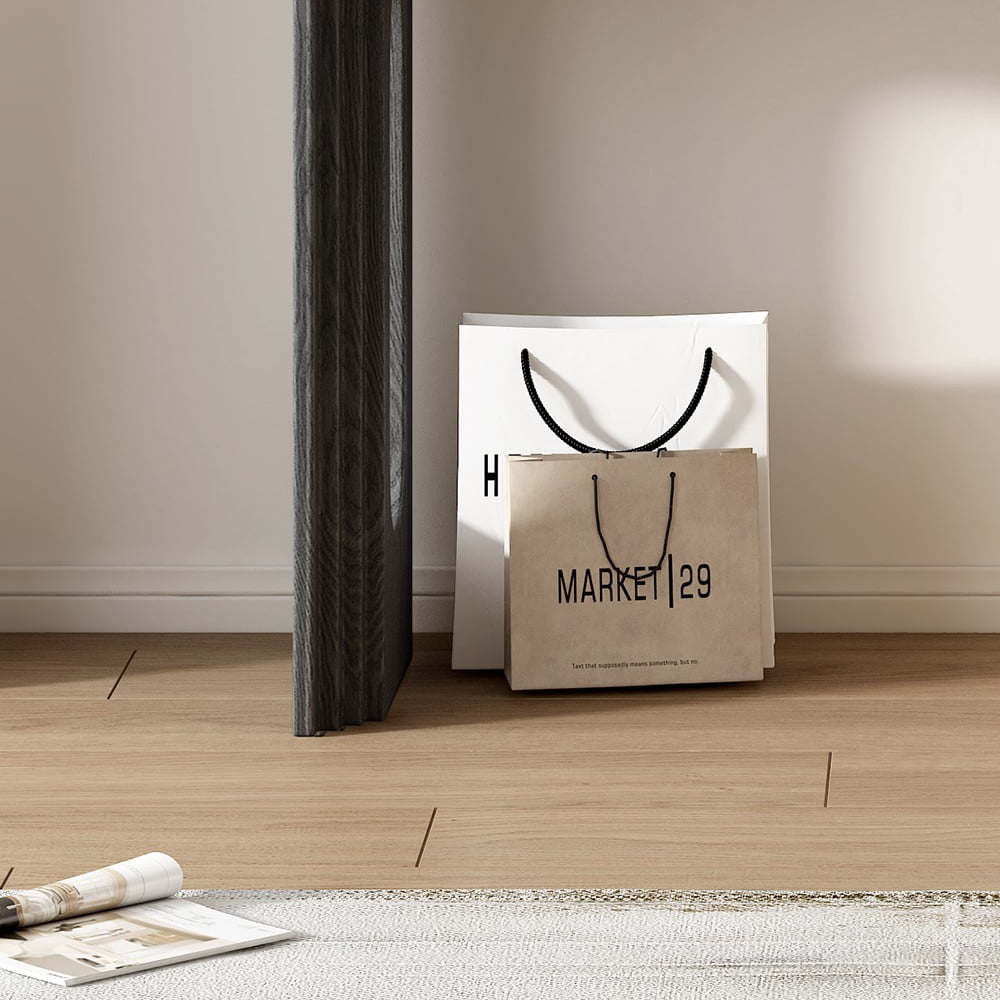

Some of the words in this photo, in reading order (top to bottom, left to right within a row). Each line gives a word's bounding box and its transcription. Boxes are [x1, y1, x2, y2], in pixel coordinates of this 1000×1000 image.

[557, 565, 661, 604] MARKET
[679, 562, 712, 600] 29
[598, 661, 629, 669] supposedly
